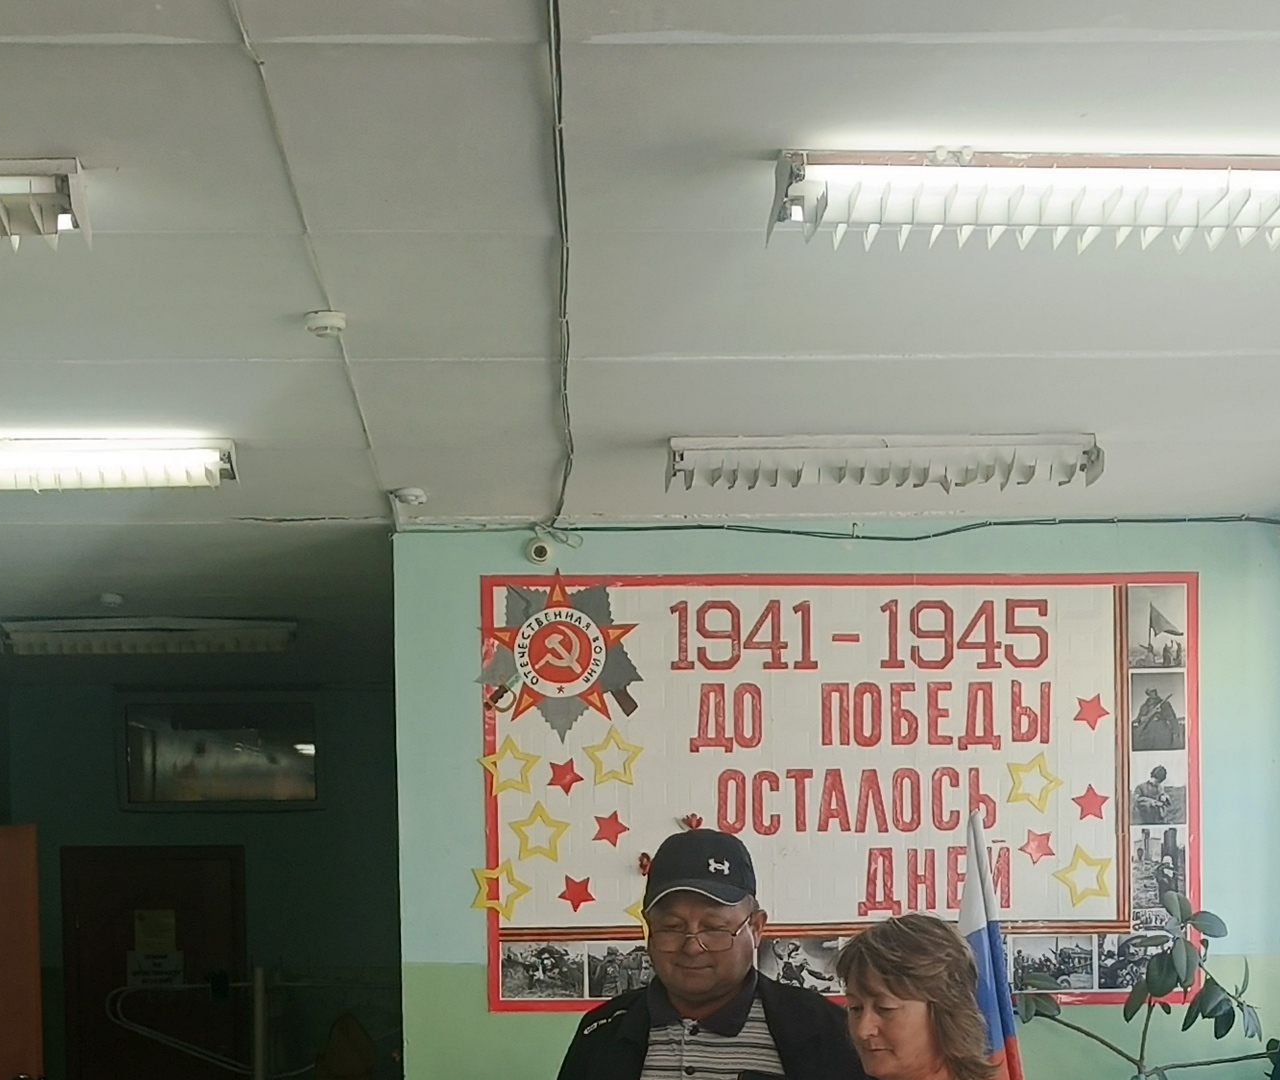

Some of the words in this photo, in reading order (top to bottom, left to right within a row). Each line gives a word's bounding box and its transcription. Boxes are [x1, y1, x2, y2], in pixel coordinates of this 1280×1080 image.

[518, 611, 591, 685] ОТЕЧЕСТВЕННАЯ
[670, 600, 818, 670] 1941
[880, 599, 1049, 669] 1945
[690, 683, 762, 752] ДО
[821, 680, 1051, 750] ПОБЕДЫ
[718, 767, 996, 835] ОСТАЛОСЬ
[858, 840, 1010, 916] ДНЕЙ
